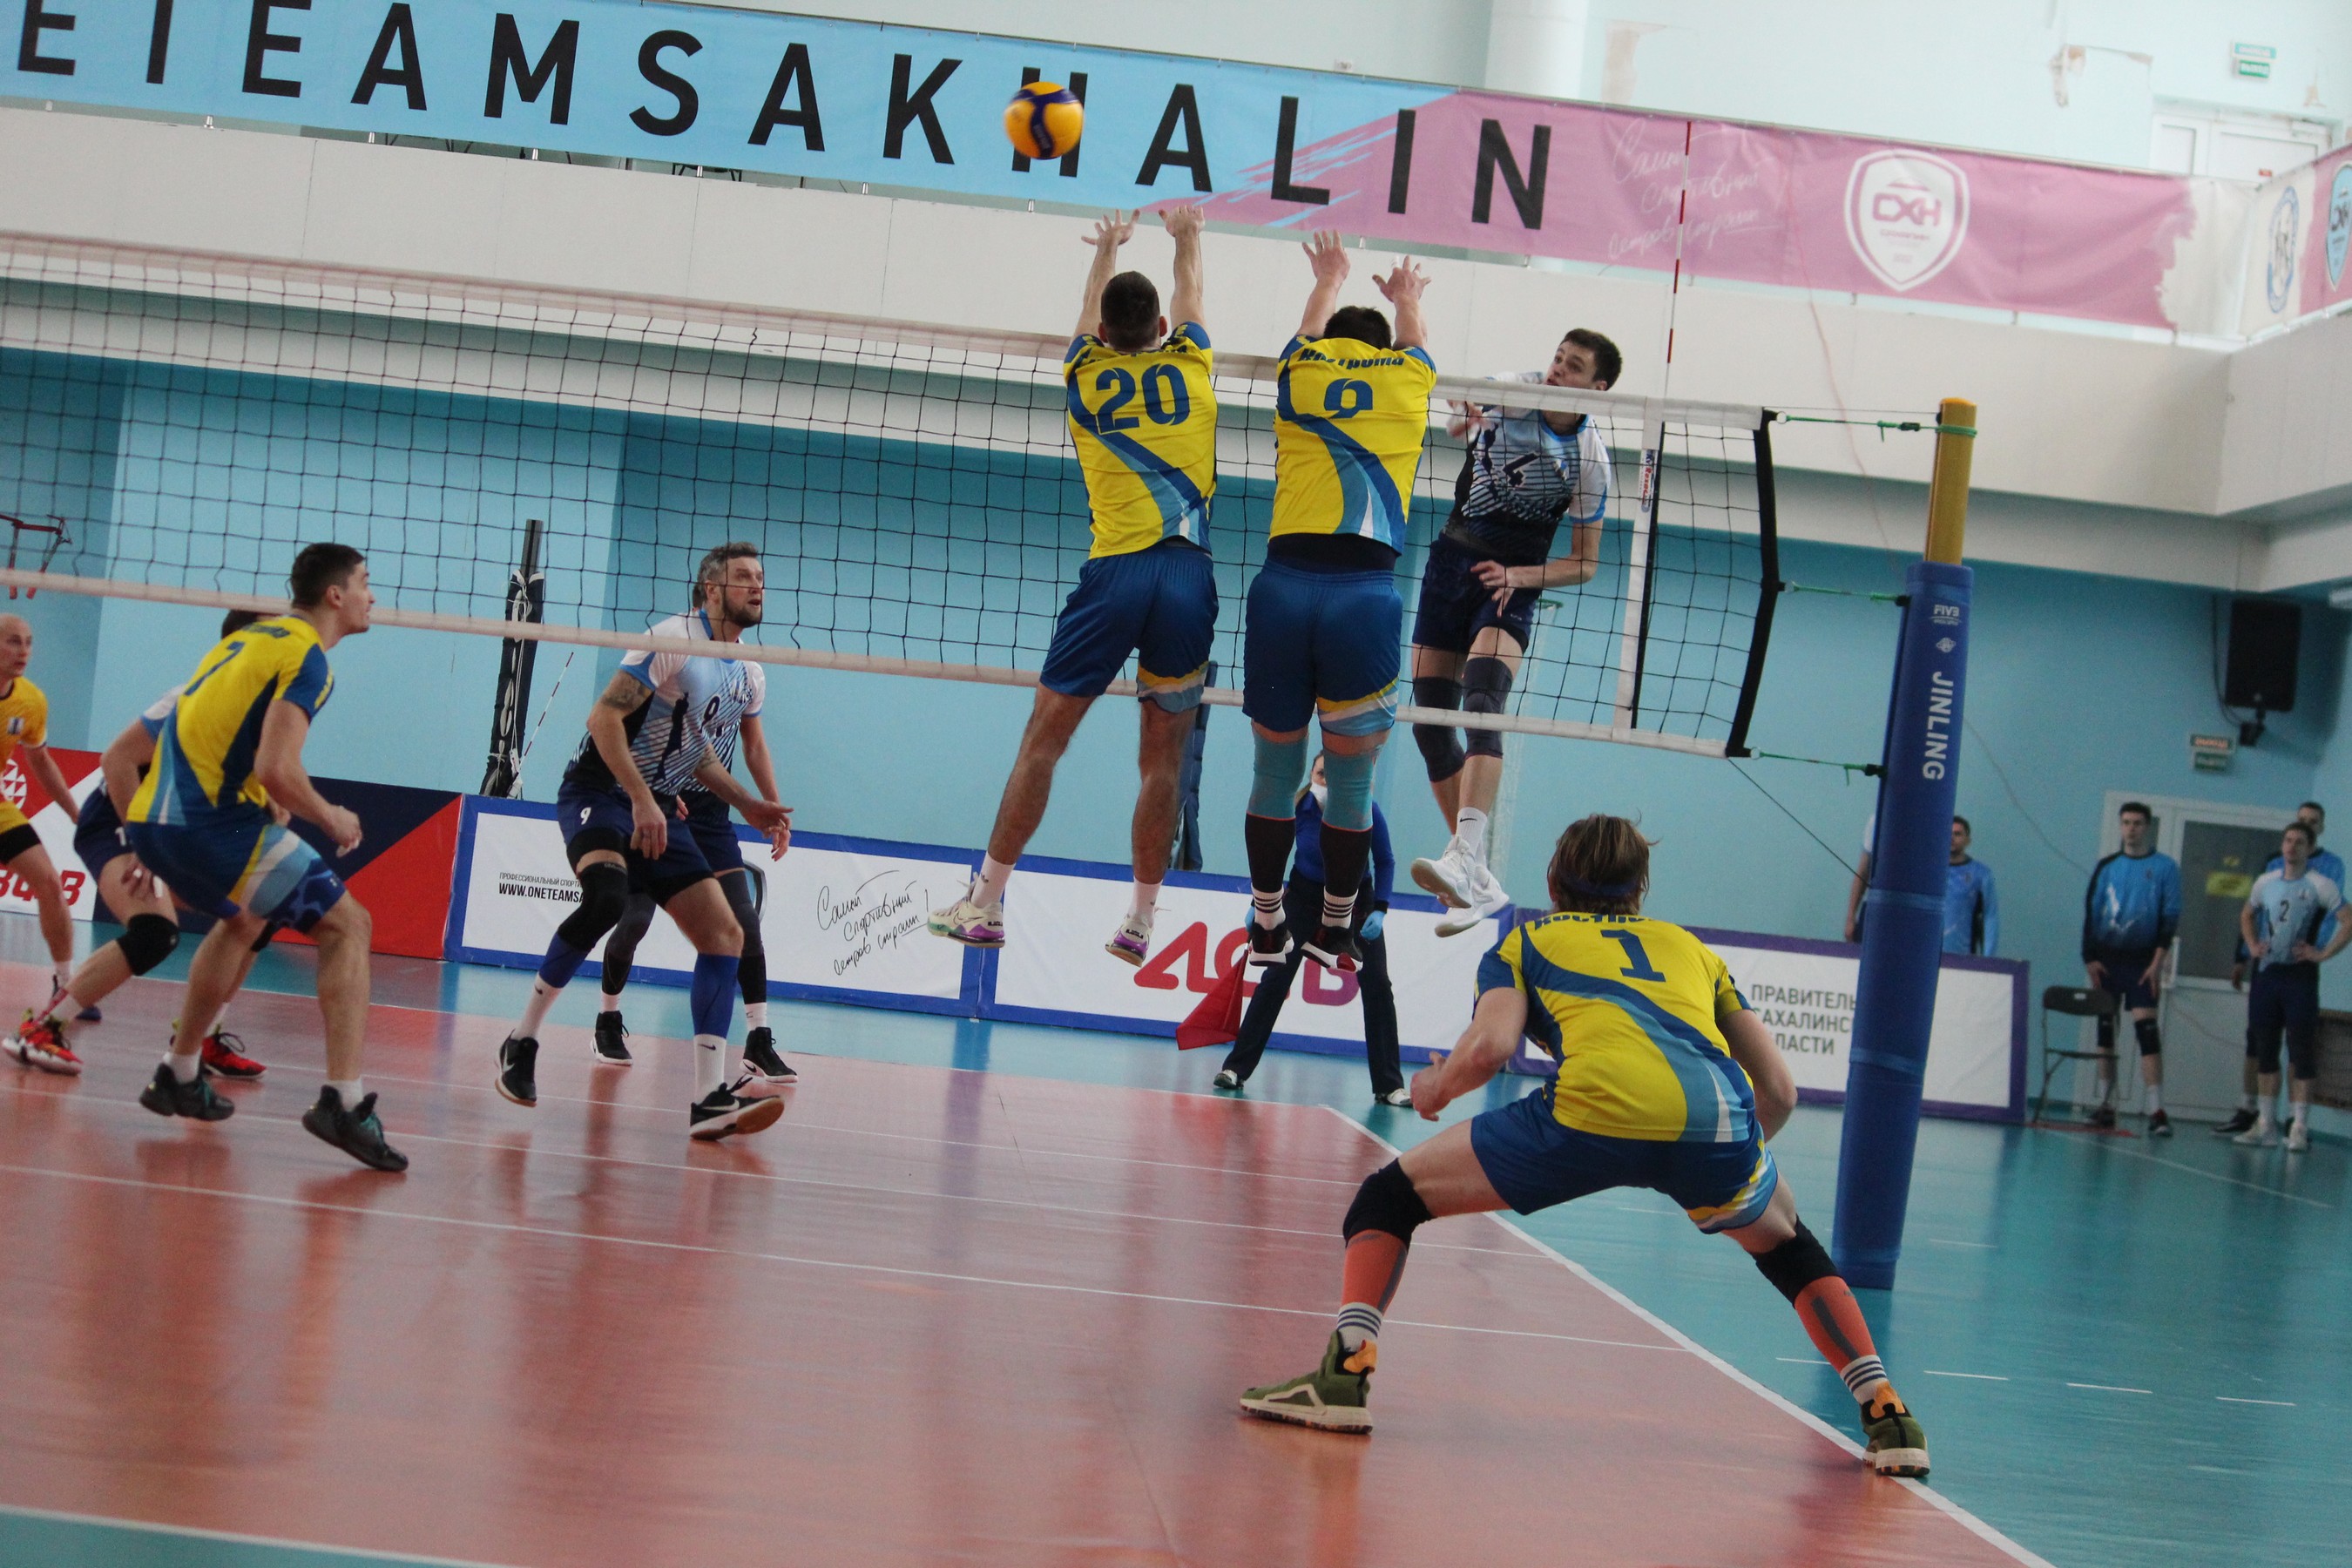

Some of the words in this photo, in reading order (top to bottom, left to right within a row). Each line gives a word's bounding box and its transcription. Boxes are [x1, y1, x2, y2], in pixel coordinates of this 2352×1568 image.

[1096, 363, 1190, 435] 20
[184, 640, 246, 696] 7
[1922, 671, 1955, 781] JINLING
[580, 807, 591, 825] 9
[499, 872, 559, 885] ПРОФЕССИОНАЛЬНЫЙ
[2279, 899, 2289, 923] 2
[1600, 929, 1666, 983] 1
